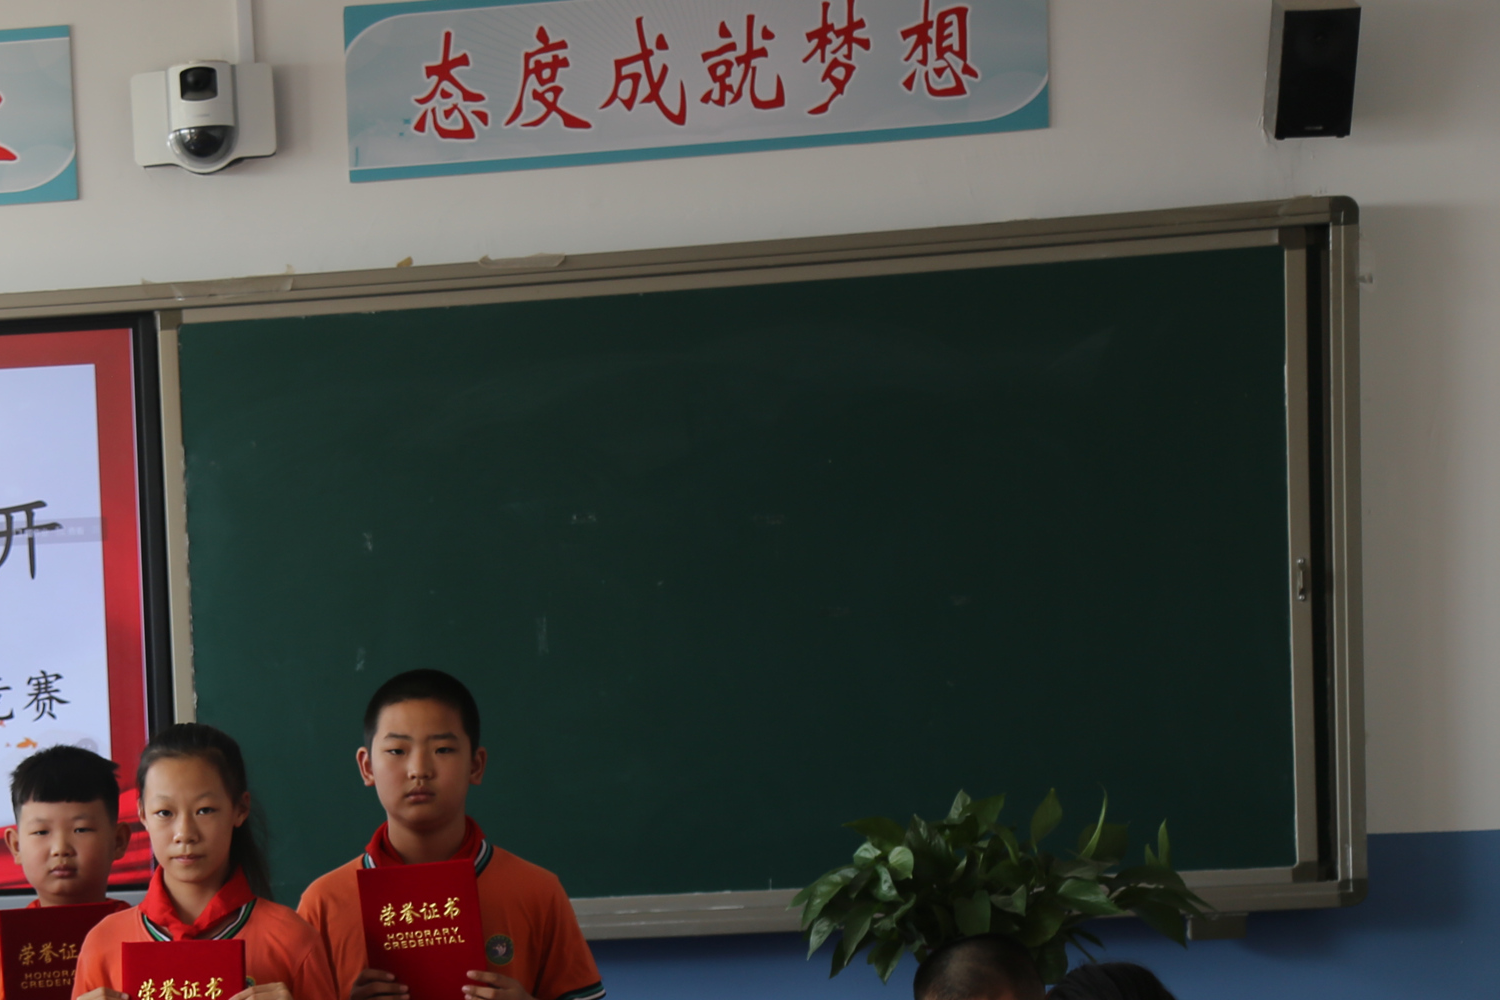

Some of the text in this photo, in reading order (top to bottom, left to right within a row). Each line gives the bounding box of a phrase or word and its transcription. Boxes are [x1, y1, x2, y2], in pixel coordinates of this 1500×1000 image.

[413, 0, 980, 142] 态度成就梦想
[380, 897, 461, 928] 荣誉证书
[386, 926, 459, 941] HONORARY
[383, 935, 466, 951] CREDENTIAL
[21, 978, 75, 990] CREDEN
